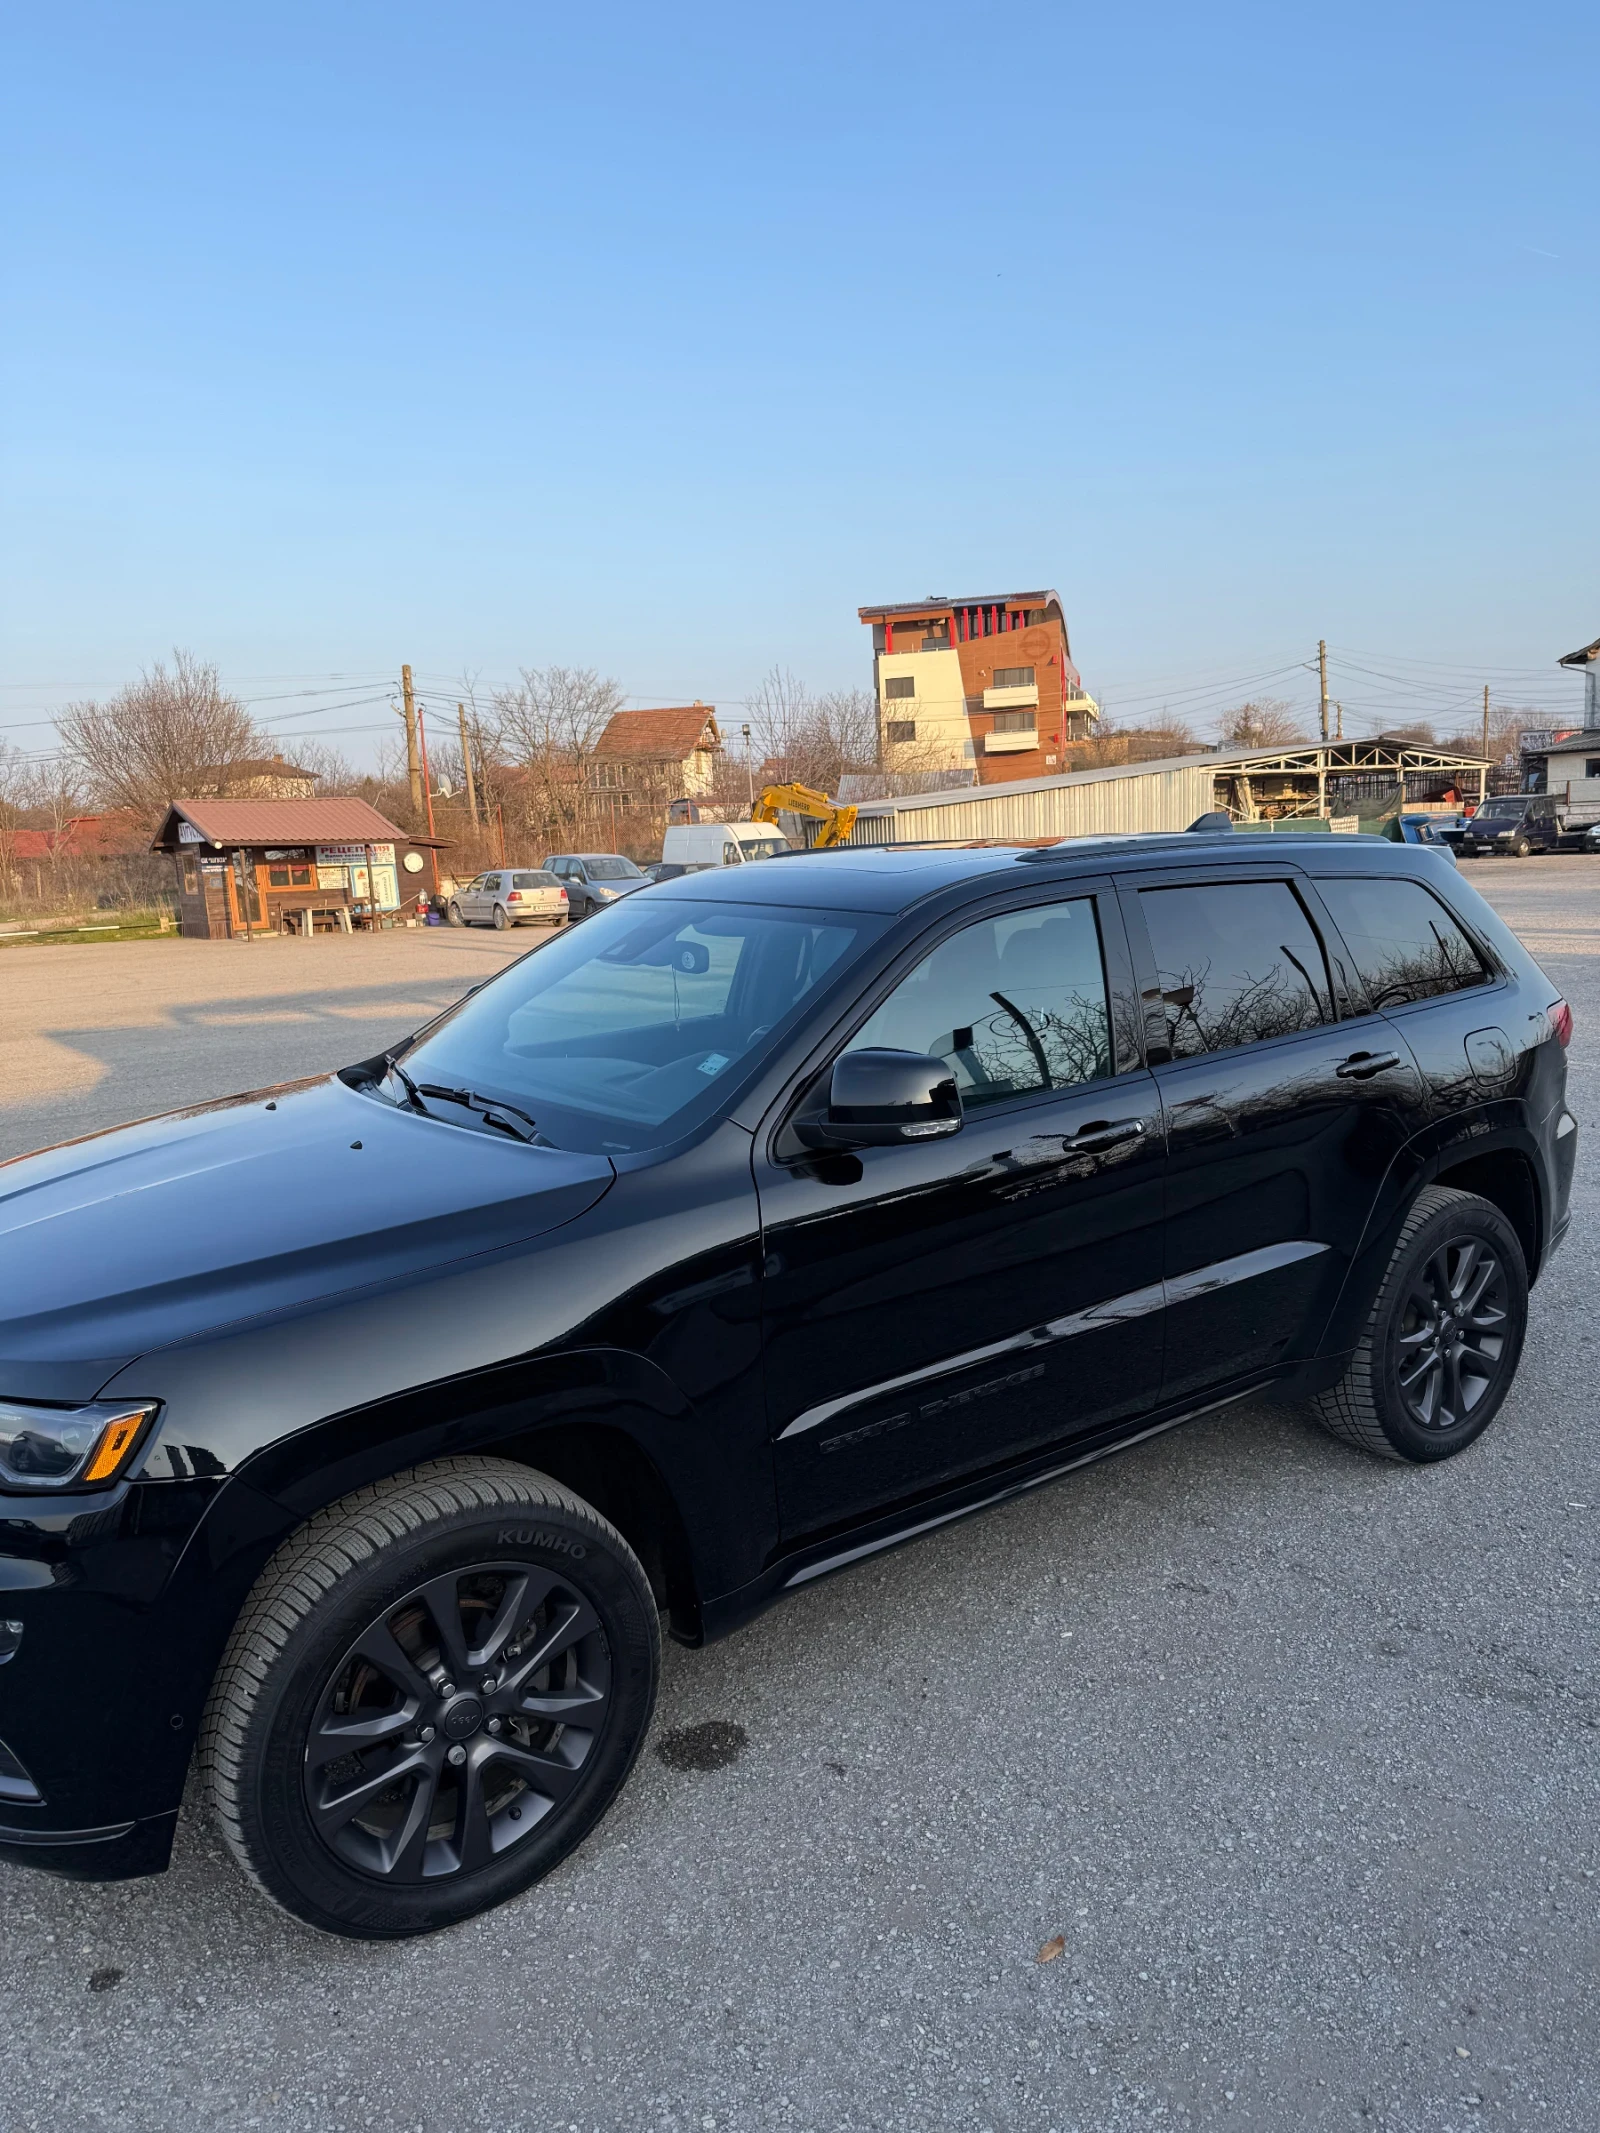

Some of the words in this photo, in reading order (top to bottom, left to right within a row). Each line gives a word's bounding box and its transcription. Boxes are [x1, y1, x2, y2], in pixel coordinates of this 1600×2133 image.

[788, 799, 810, 811] LIEBHERR
[321, 845, 390, 854] РЕЦЕПИЯ
[819, 1412, 912, 1455] GRAND
[919, 1363, 1046, 1418] CHEROKEE
[497, 1529, 587, 1560] KUMHO
